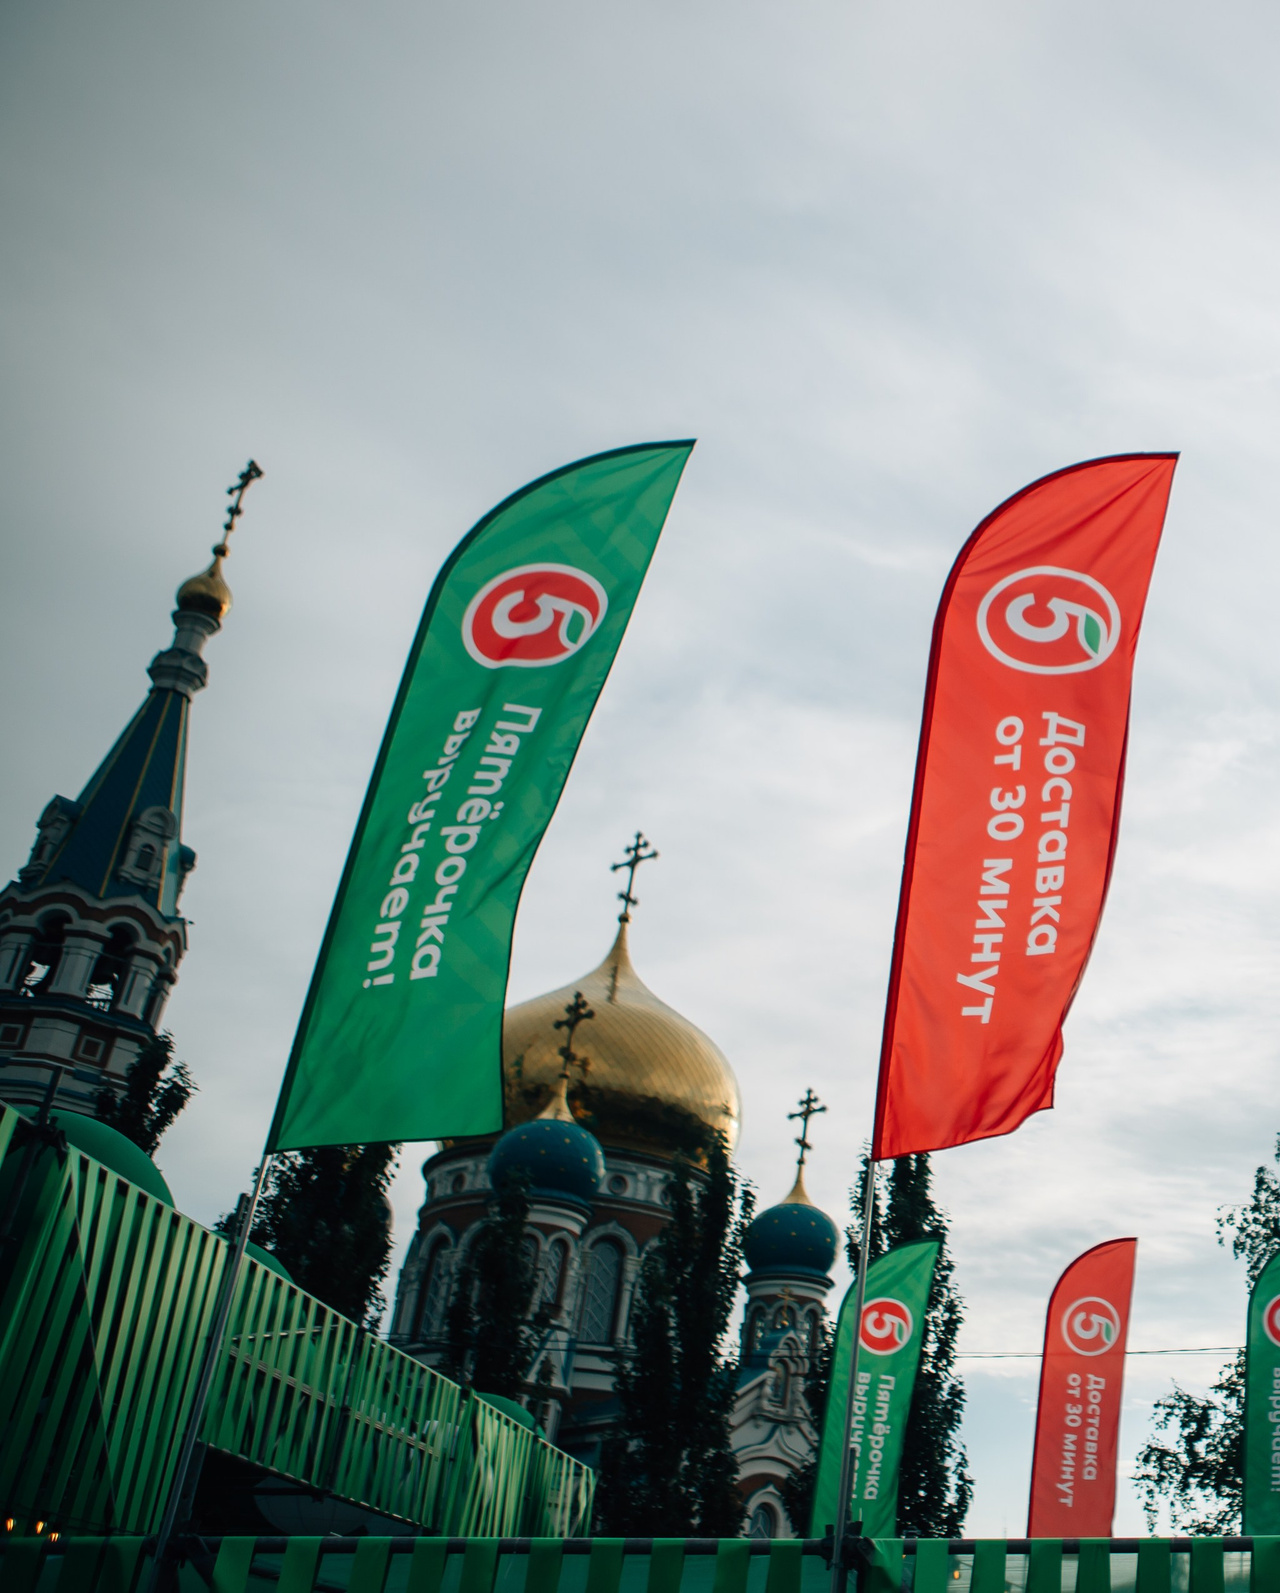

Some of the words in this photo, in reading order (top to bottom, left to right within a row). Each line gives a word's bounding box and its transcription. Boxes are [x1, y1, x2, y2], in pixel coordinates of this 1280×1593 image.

[994, 716, 1025, 771] от
[363, 707, 482, 989] выручает!
[410, 703, 542, 981] Пятёрочка
[986, 785, 1026, 841] 30
[1026, 712, 1086, 957] Доставка
[956, 858, 1013, 1024] минут
[863, 1374, 896, 1500] Пятёрочка
[1064, 1404, 1083, 1428] 30
[1066, 1373, 1081, 1400] от
[1083, 1373, 1106, 1481] Доставка
[1055, 1434, 1075, 1508] минут
